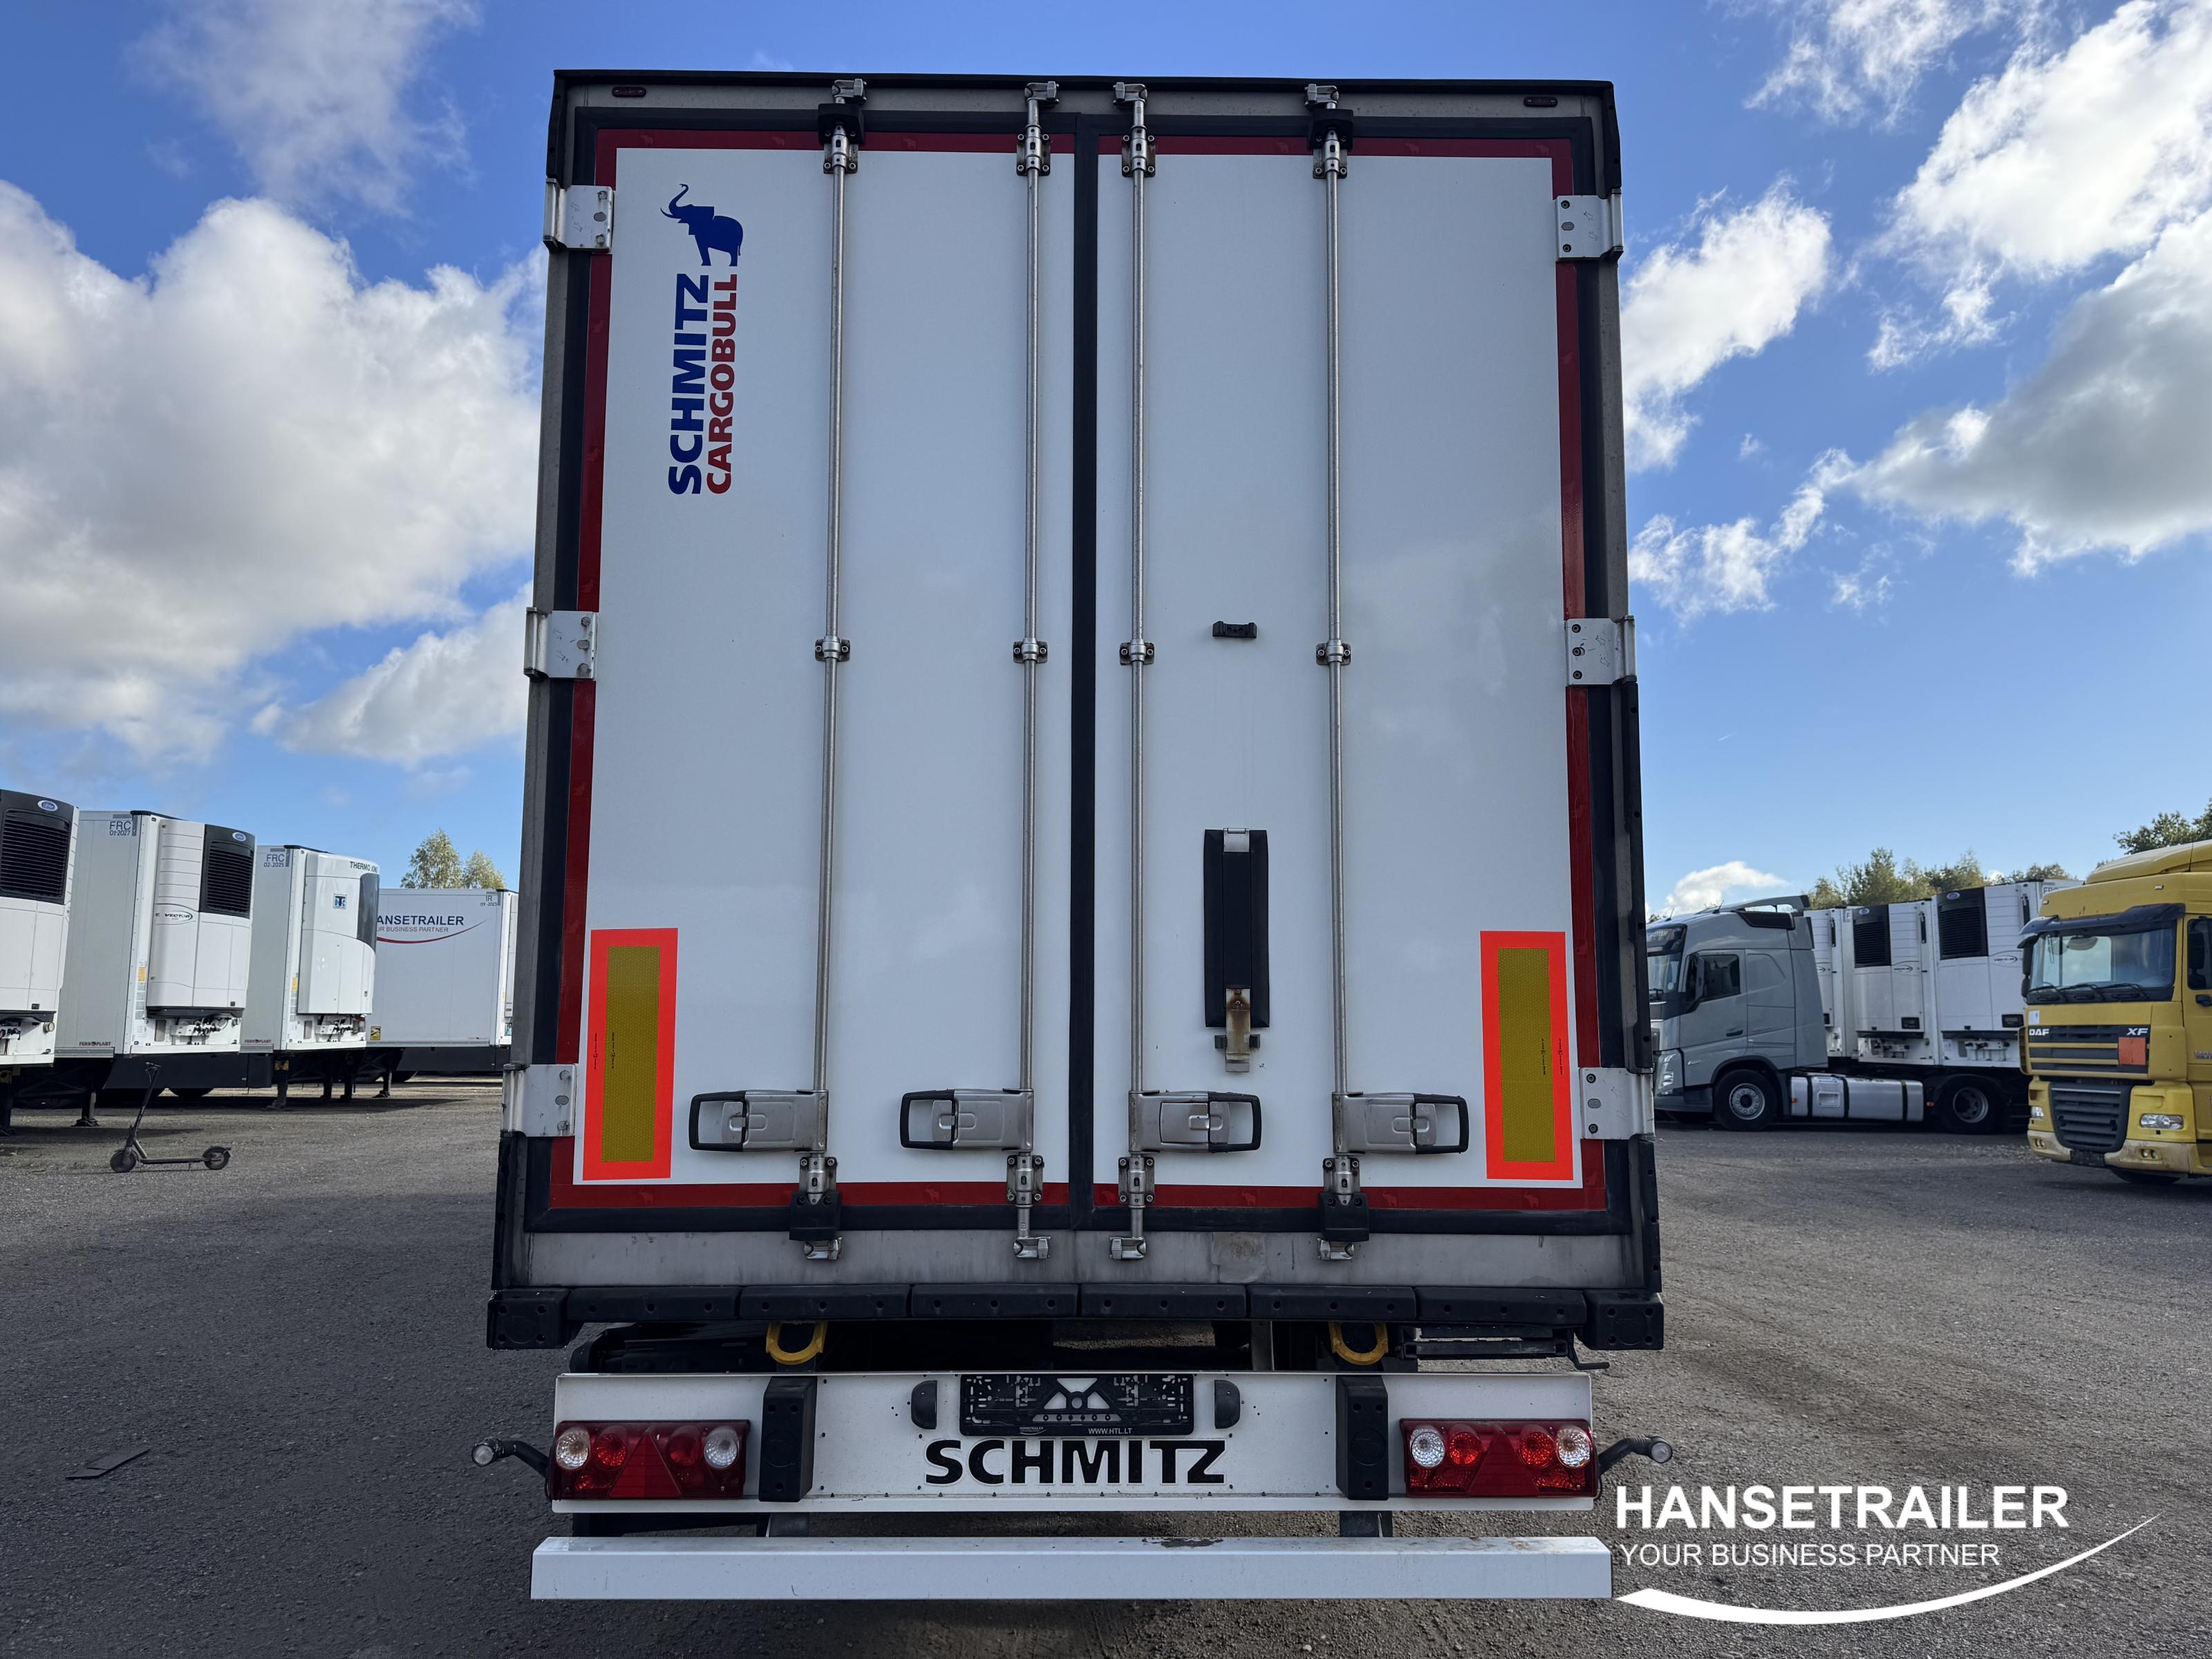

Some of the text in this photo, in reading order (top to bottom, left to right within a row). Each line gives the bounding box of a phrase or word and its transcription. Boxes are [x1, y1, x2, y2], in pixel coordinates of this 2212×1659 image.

[668, 273, 709, 494] SCHMITZ
[706, 274, 738, 494] CARGOBULL
[110, 821, 131, 830] FRC
[266, 854, 285, 862] FRC
[349, 861, 371, 871] THERMO
[377, 915, 465, 926] ANSETRAILER
[2029, 1028, 2050, 1036] DAF
[926, 1440, 1226, 1484] SCHMITZ
